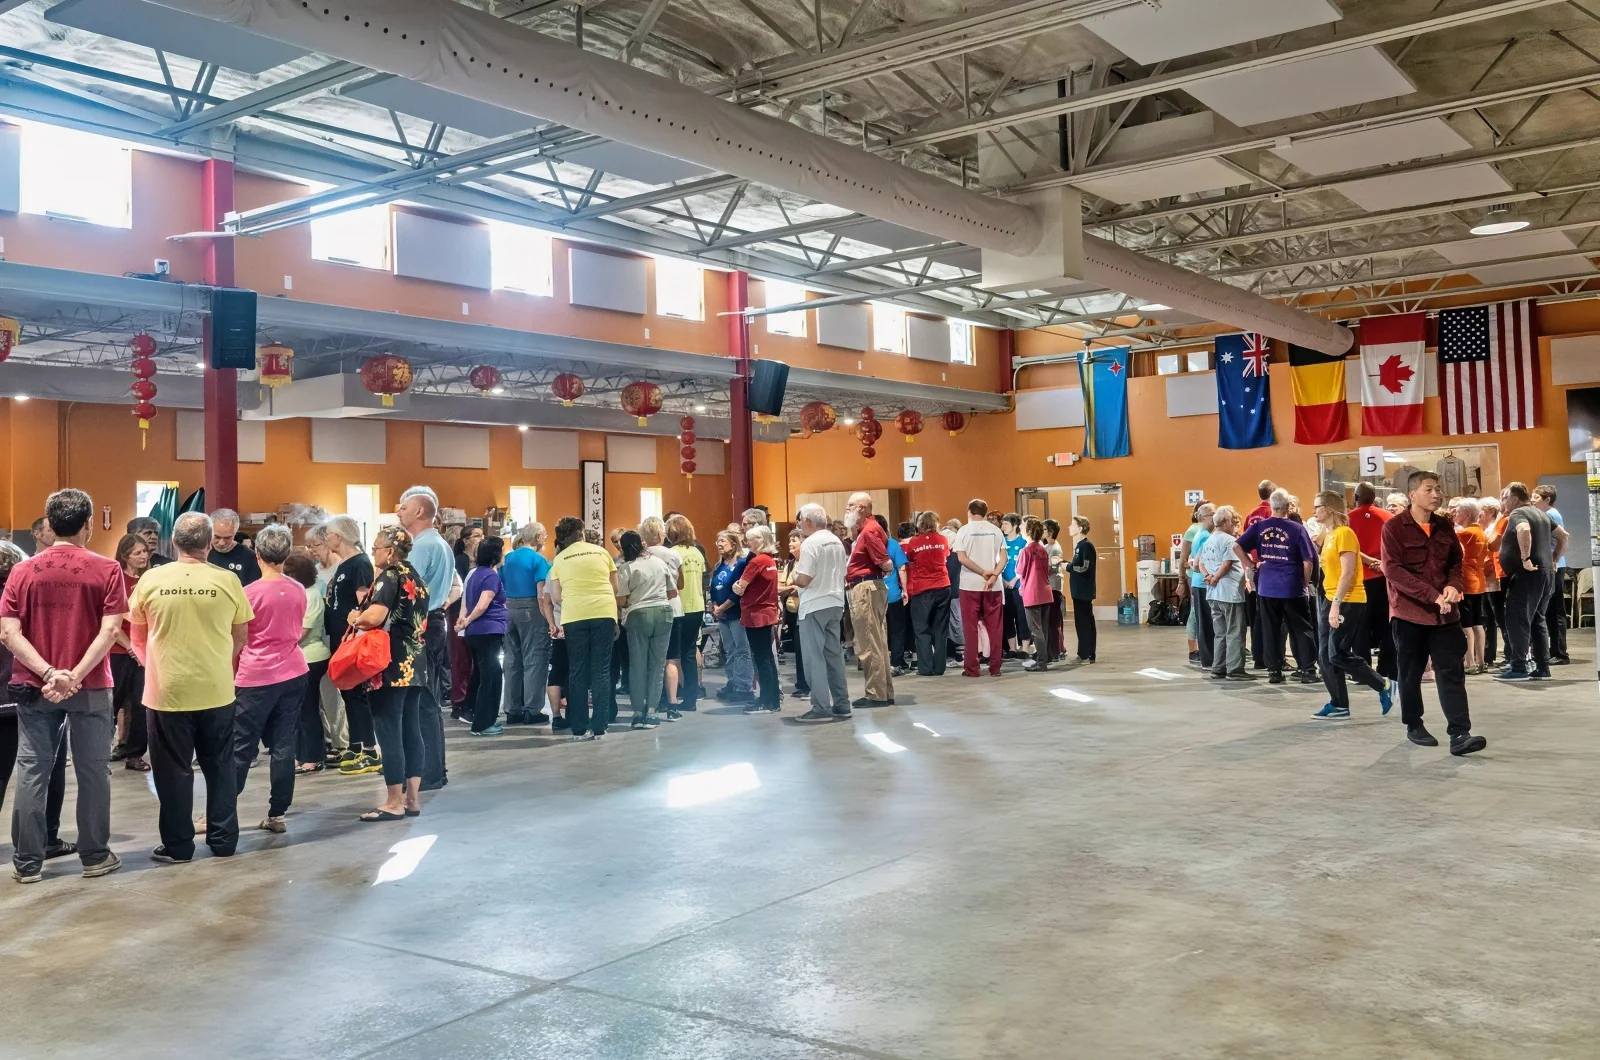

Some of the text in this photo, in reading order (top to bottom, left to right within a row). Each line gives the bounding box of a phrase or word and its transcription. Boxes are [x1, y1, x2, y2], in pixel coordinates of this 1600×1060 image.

[1366, 456, 1378, 473] 5
[908, 465, 918, 479] 7
[159, 587, 217, 598] taoist.org
